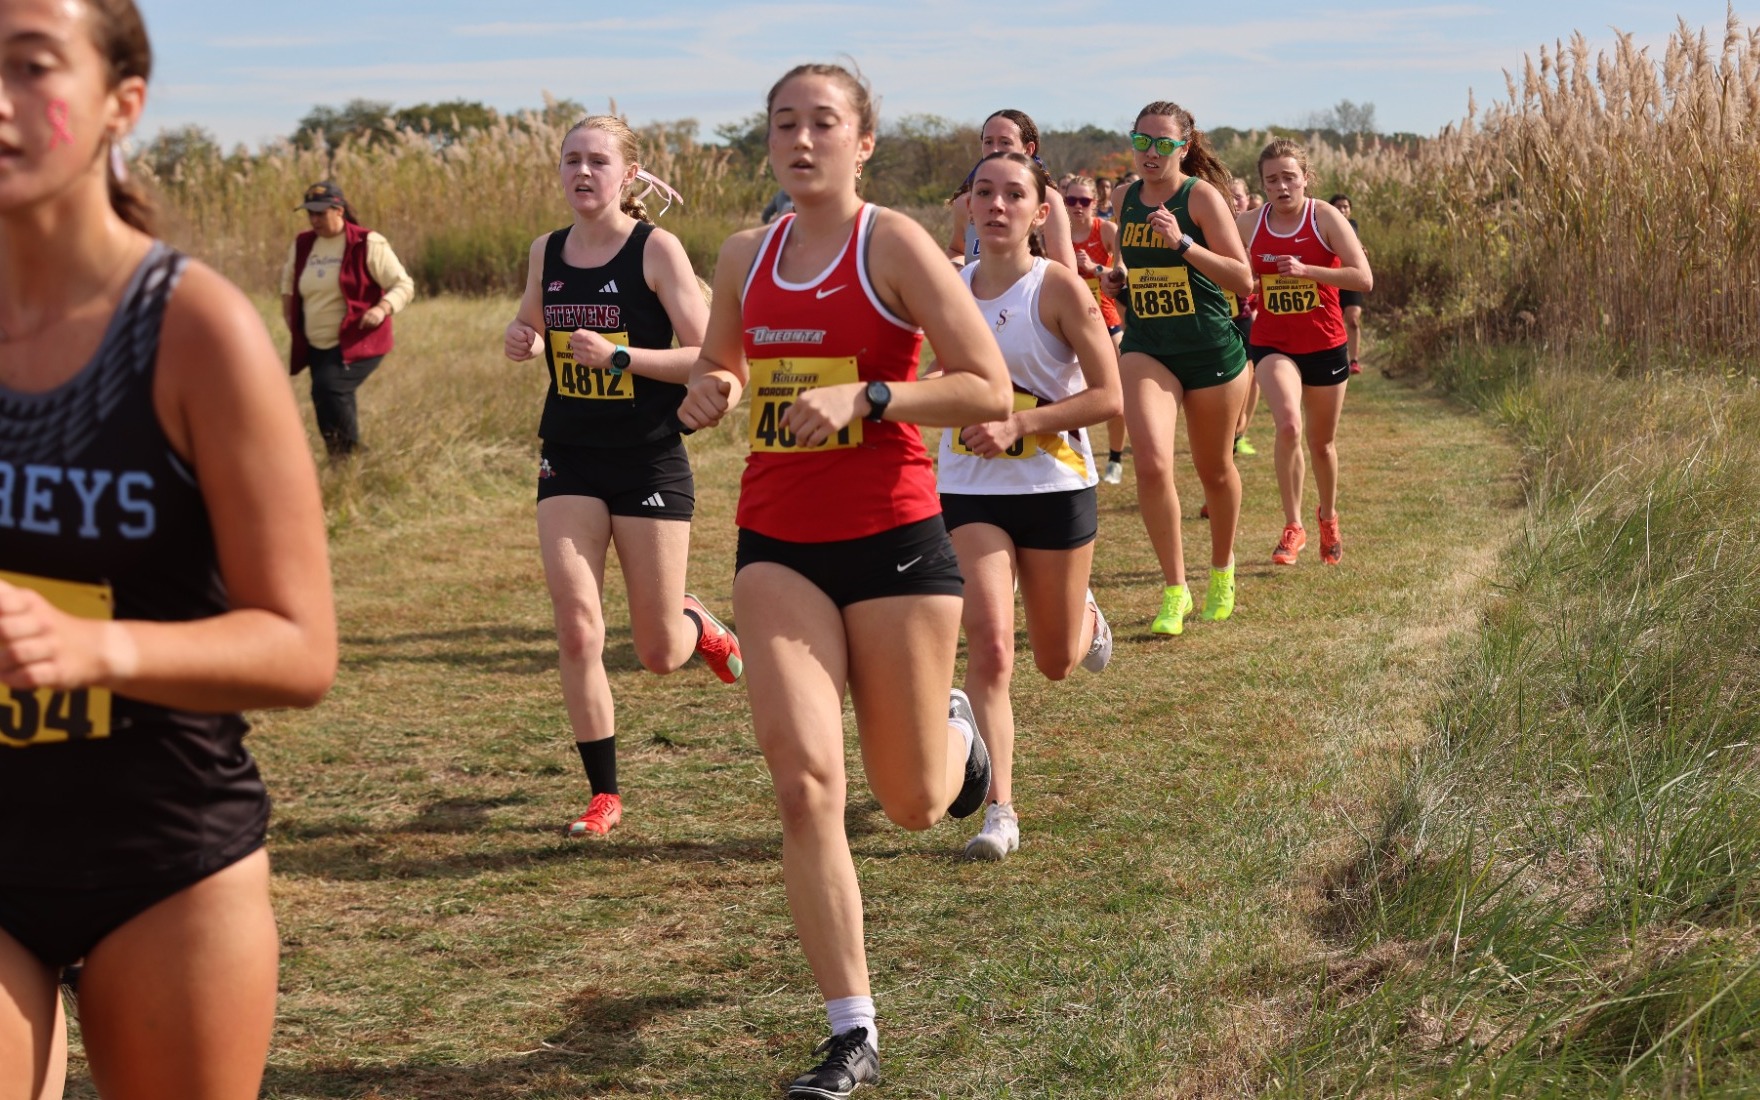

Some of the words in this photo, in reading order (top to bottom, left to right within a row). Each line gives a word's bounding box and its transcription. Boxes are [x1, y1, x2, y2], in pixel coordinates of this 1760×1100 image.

[1134, 289, 1190, 316] 4836
[1268, 290, 1316, 313] 4662
[544, 304, 620, 329] STEVENS
[556, 351, 575, 360] BOR
[562, 362, 625, 397] 4812
[757, 386, 795, 397] BORDER
[756, 401, 850, 448] 41
[0, 687, 94, 740] 34
